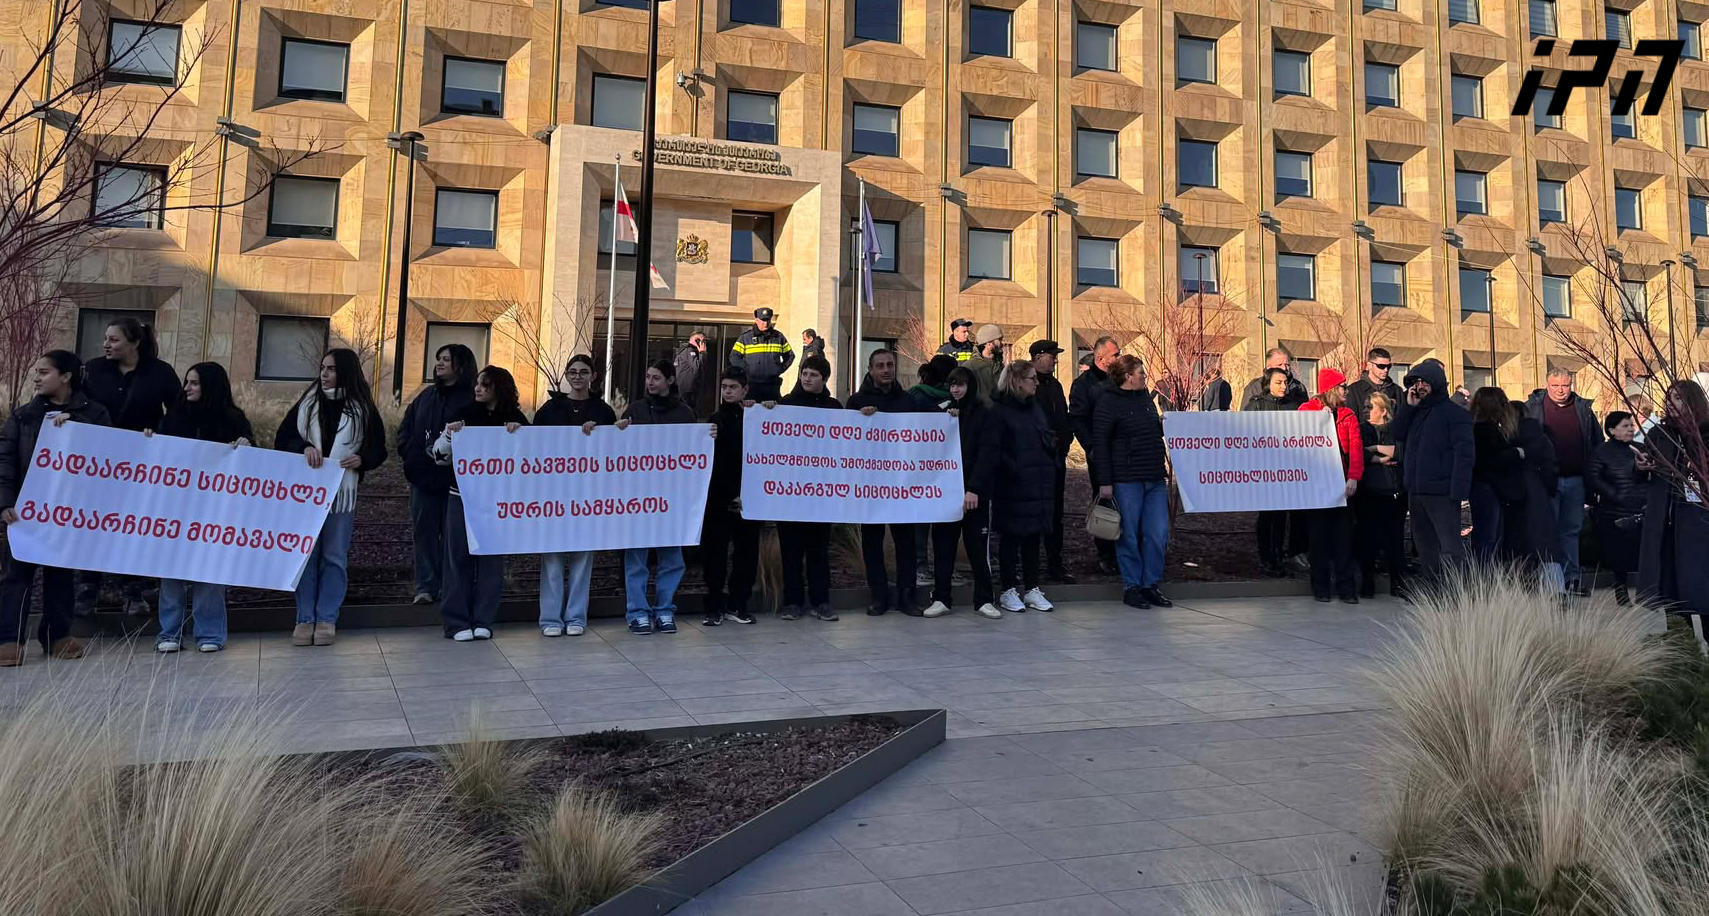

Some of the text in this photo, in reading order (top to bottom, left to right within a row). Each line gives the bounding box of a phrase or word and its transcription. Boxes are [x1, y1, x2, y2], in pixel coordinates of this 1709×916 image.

[655, 138, 720, 155] ქართველოს
[632, 149, 789, 176] GERNMENT OF GEORGIA
[761, 420, 946, 443] ყოველი დღე ძვირფასია
[1168, 435, 1333, 450] ყოველი დღე არის ბრძოლა
[457, 453, 708, 476] ერთი ბავშვის სიცოცხლე
[746, 452, 958, 472] სახელმწიფოს უმოქმედობა უდრის
[36, 448, 331, 510] გადაარჩინე სიცოცხლე,
[1199, 468, 1308, 485] სიცოცხლისთვის
[763, 480, 943, 500] დაკარგულ სიცოცხლეს
[497, 496, 669, 519] უდრის სამყაროს
[20, 500, 314, 555] გადაარჩინე მომავალი
